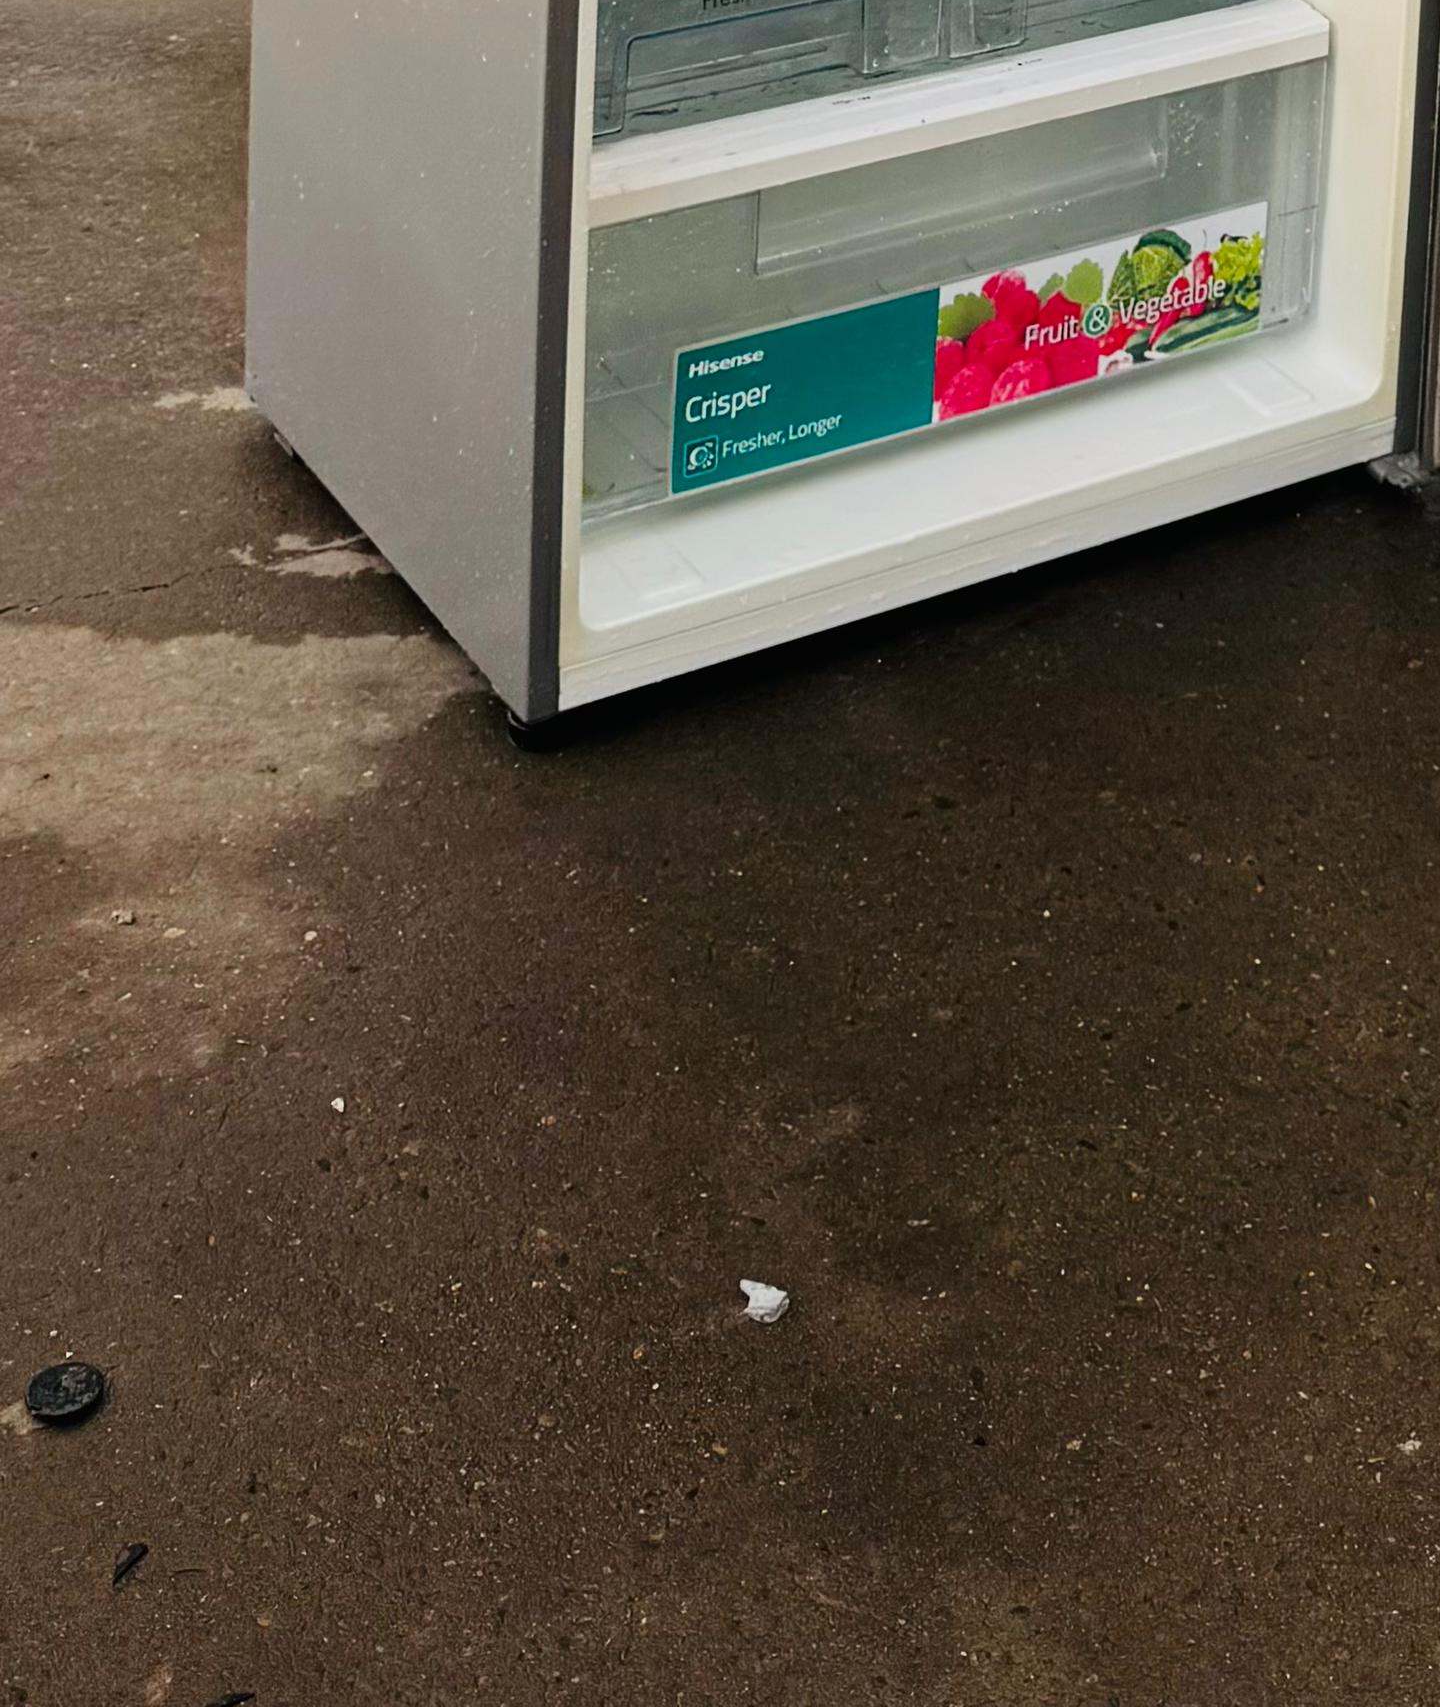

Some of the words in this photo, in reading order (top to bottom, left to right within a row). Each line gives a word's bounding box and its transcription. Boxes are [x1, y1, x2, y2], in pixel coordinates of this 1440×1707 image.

[1023, 316, 1080, 351] Fruit
[1118, 275, 1226, 325] Vegetable
[688, 349, 765, 379] Hisense
[685, 383, 772, 423] Crisper
[721, 430, 786, 458] Fresher,
[788, 414, 842, 440] Longer
